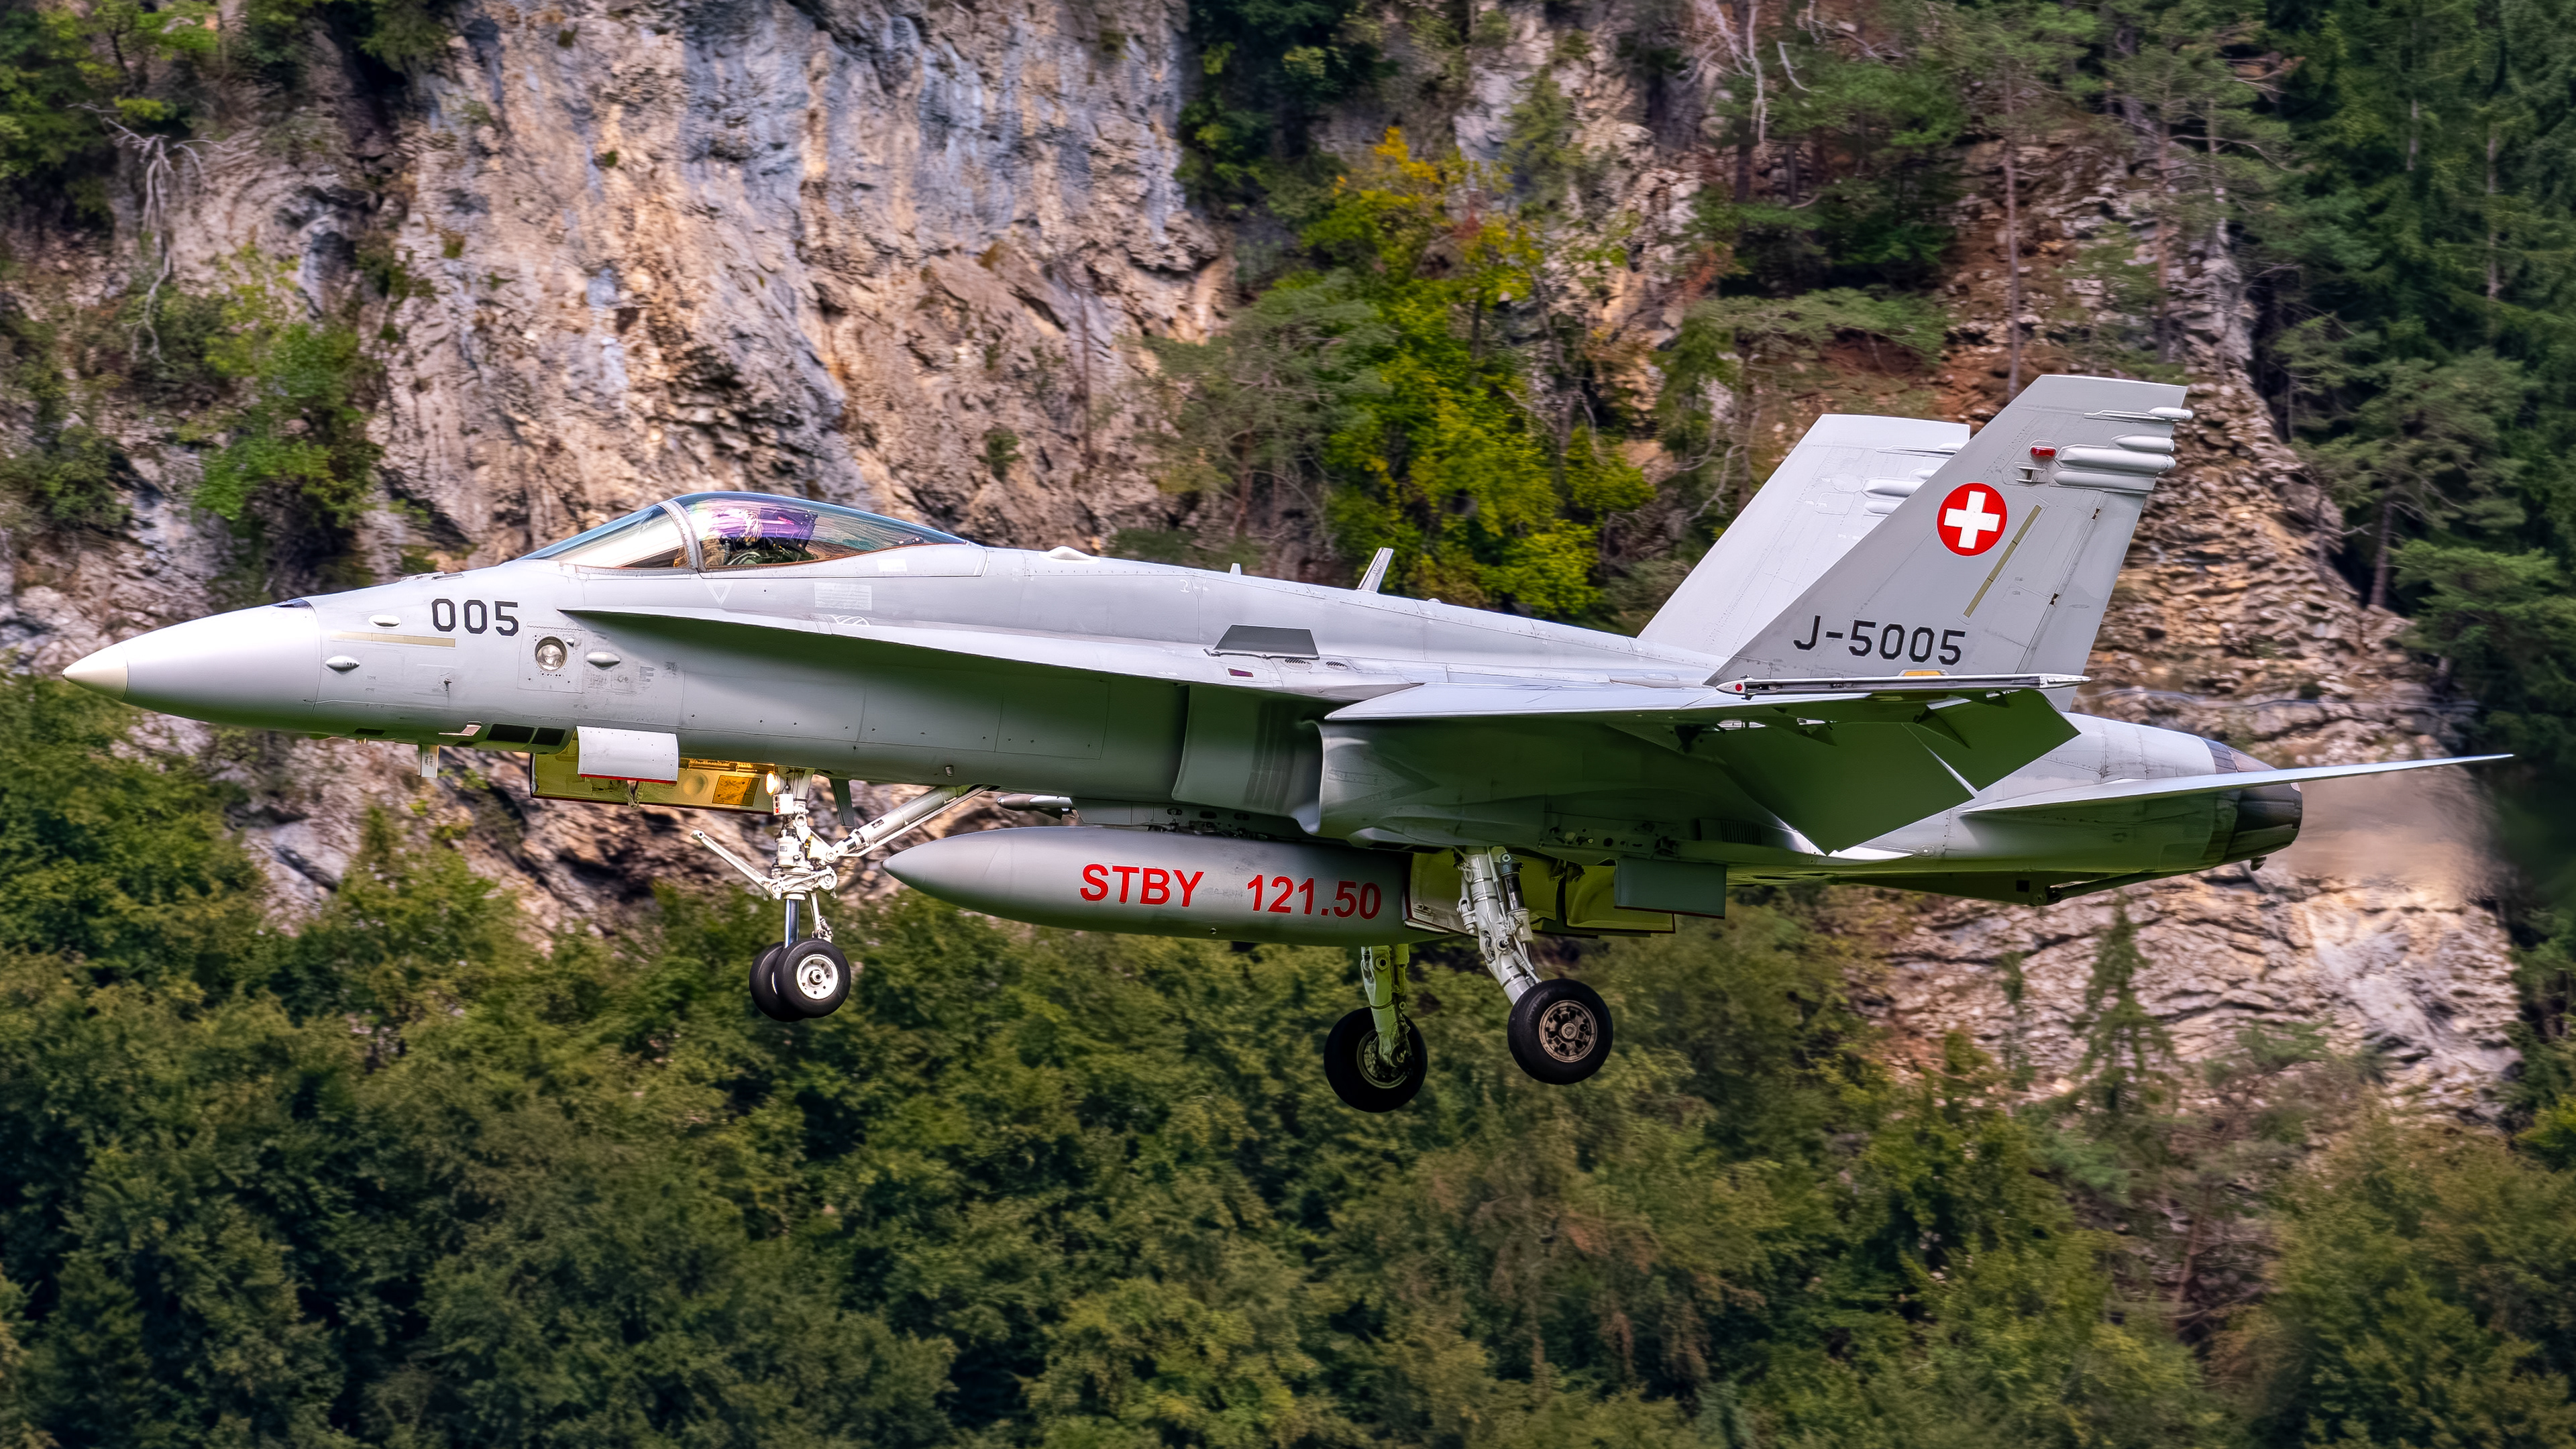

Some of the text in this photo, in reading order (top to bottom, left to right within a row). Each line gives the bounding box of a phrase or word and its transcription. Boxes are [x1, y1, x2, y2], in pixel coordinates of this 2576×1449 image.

[431, 598, 519, 637] 005
[1793, 614, 1966, 666] J-5005
[1079, 863, 1382, 920] STBY 121.50
